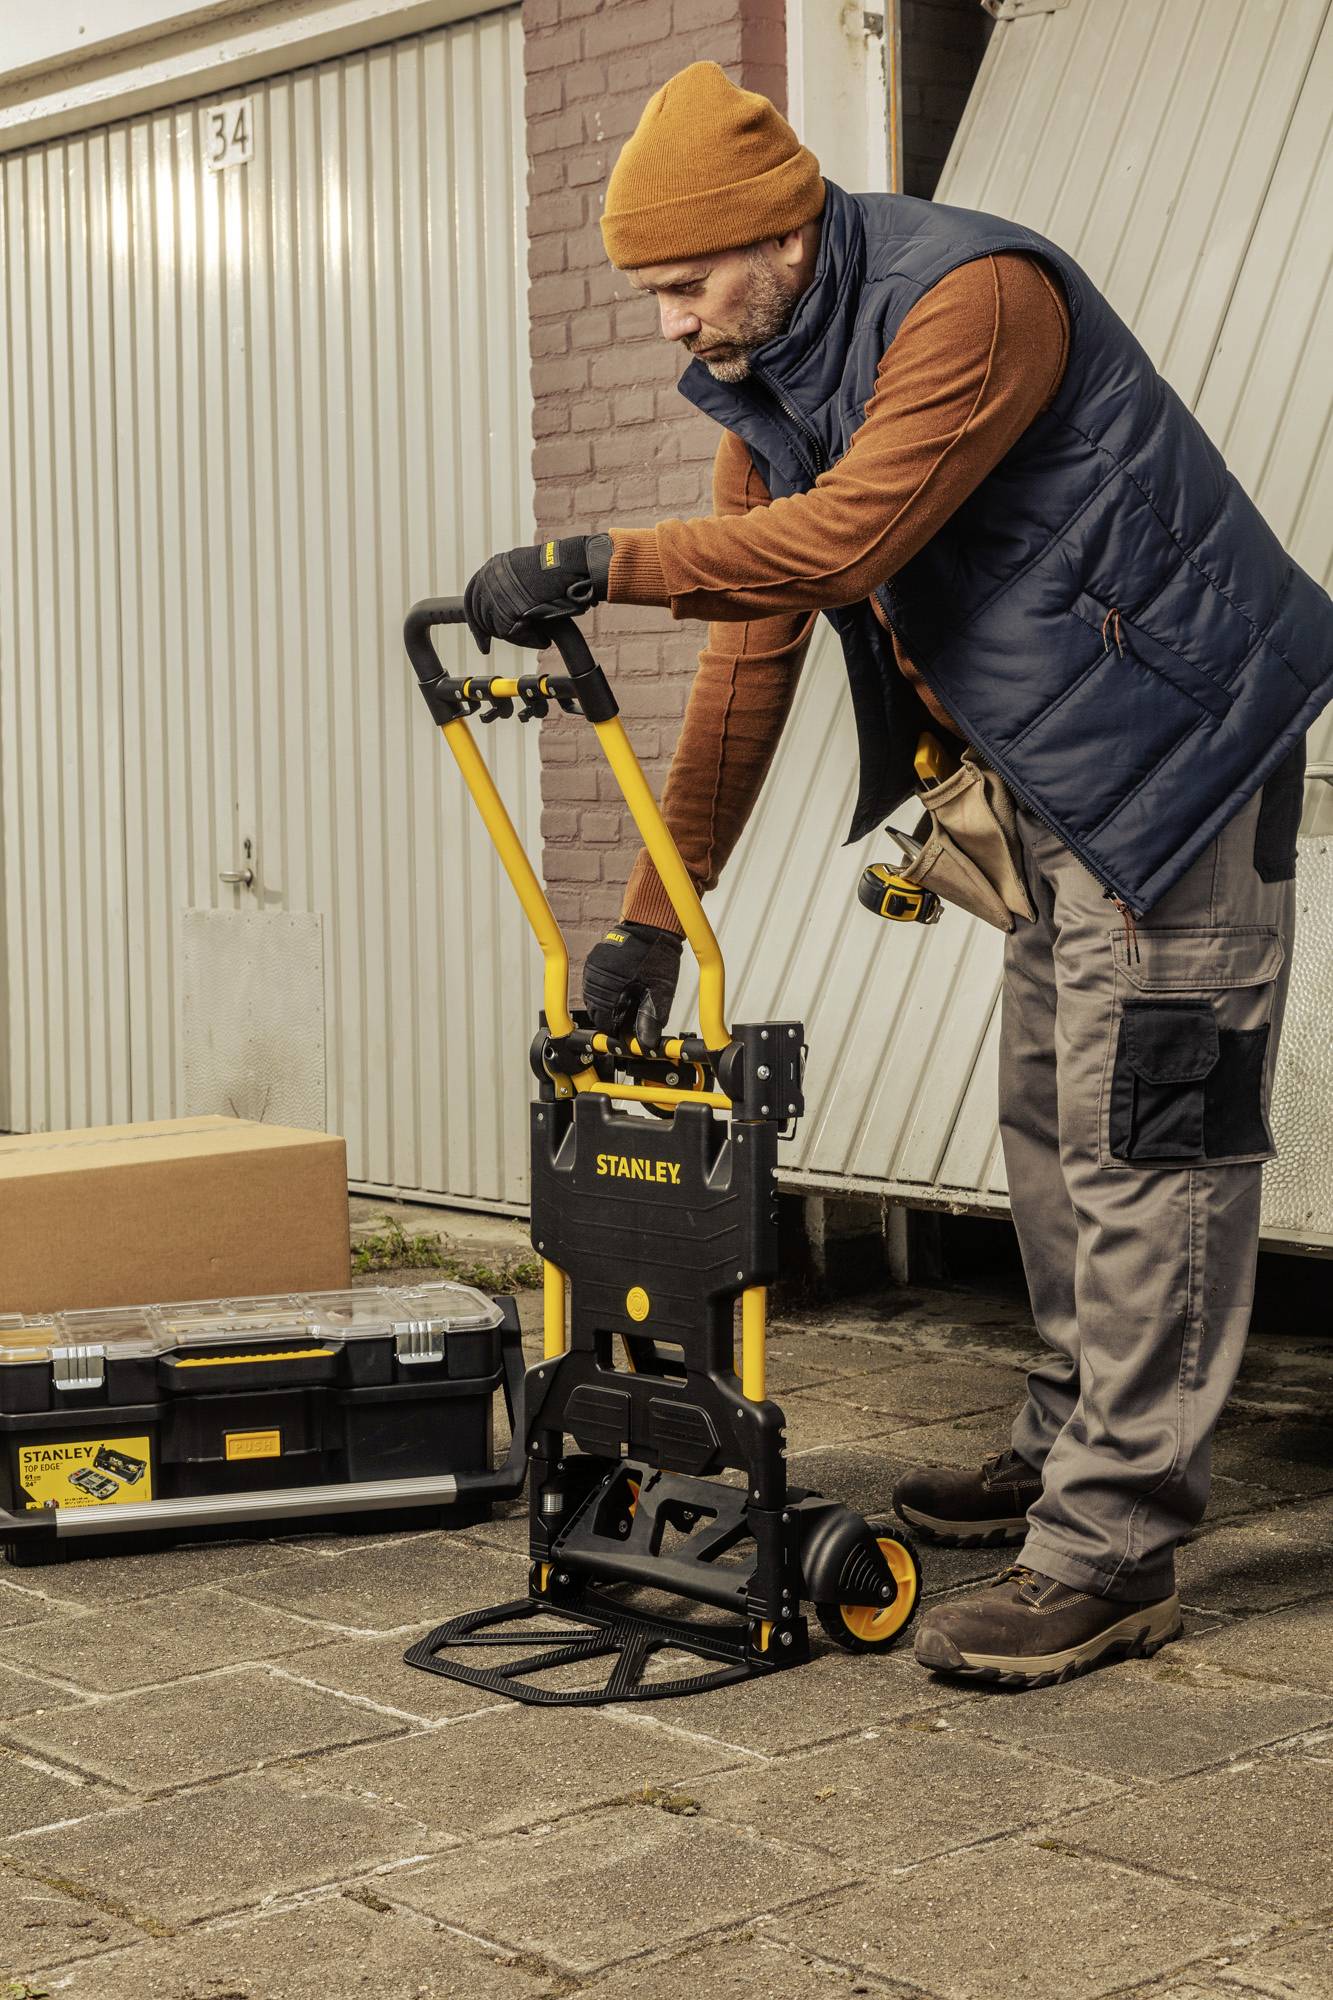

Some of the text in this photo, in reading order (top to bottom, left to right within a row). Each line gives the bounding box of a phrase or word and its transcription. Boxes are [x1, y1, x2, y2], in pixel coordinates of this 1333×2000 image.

[212, 106, 248, 162] 34
[596, 1153, 681, 1185] STANLEY
[23, 1446, 94, 1463] STANLEY
[233, 1439, 273, 1454] PUSH
[24, 1462, 60, 1473] TOP EDGE
